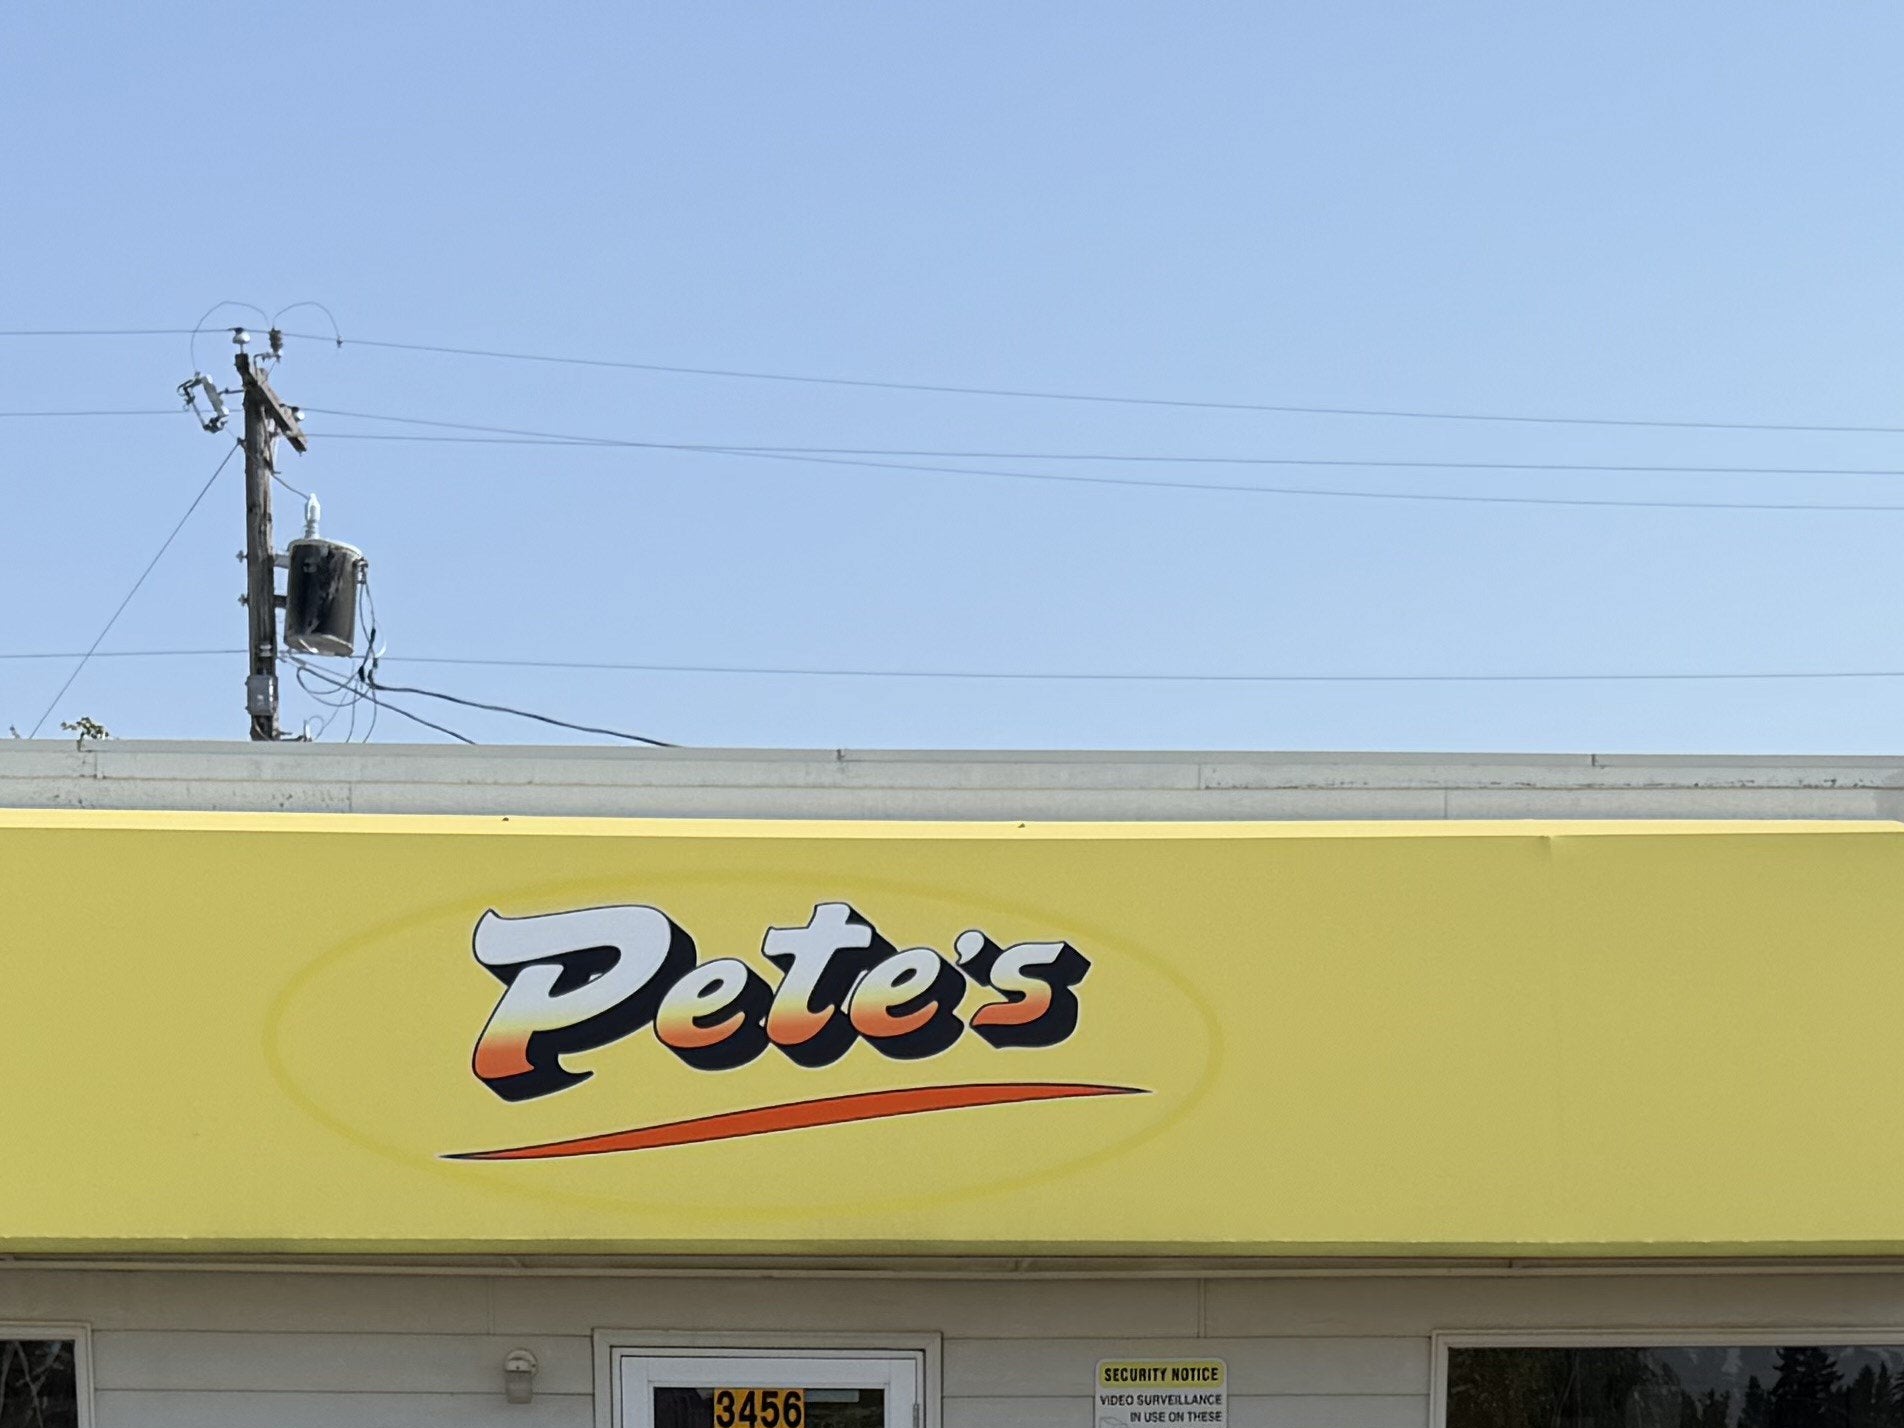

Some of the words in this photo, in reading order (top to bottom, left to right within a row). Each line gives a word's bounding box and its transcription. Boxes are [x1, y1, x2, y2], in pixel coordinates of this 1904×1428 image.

[472, 903, 1090, 1102] Pete's
[1104, 1367, 1167, 1381] SECURITY
[1172, 1367, 1219, 1381] NOTICE
[1100, 1394, 1134, 1406] VIDEO
[1137, 1394, 1222, 1406] SURVEILLANCE
[715, 1390, 802, 1428] 3456
[1130, 1411, 1141, 1422] IN
[1144, 1411, 1165, 1422] USE
[1168, 1411, 1184, 1422] ON
[1187, 1411, 1222, 1422] THESE
